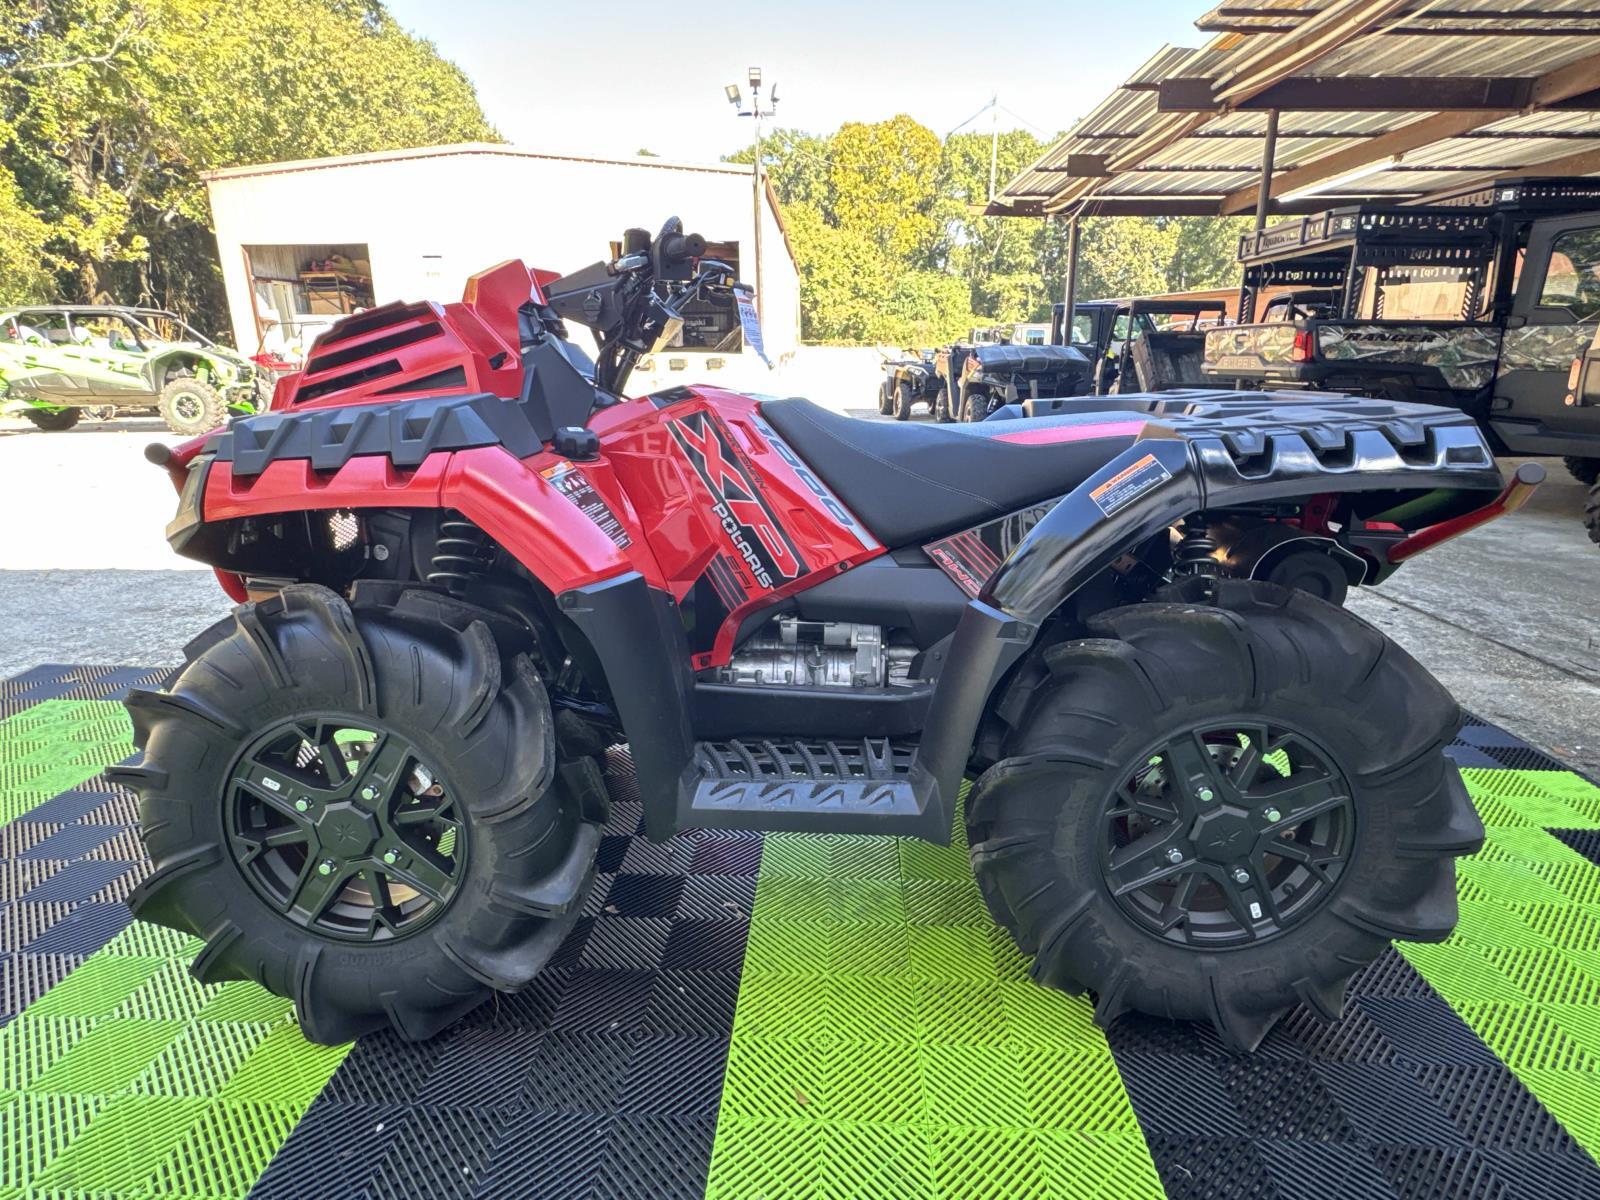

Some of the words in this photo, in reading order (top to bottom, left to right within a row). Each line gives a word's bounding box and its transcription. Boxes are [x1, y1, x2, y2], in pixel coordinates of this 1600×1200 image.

[1343, 332, 1438, 343] RANGER
[673, 411, 800, 578] XP
[712, 501, 775, 591] POLARIS
[726, 555, 754, 590] EFI
[932, 548, 981, 596] AWD
